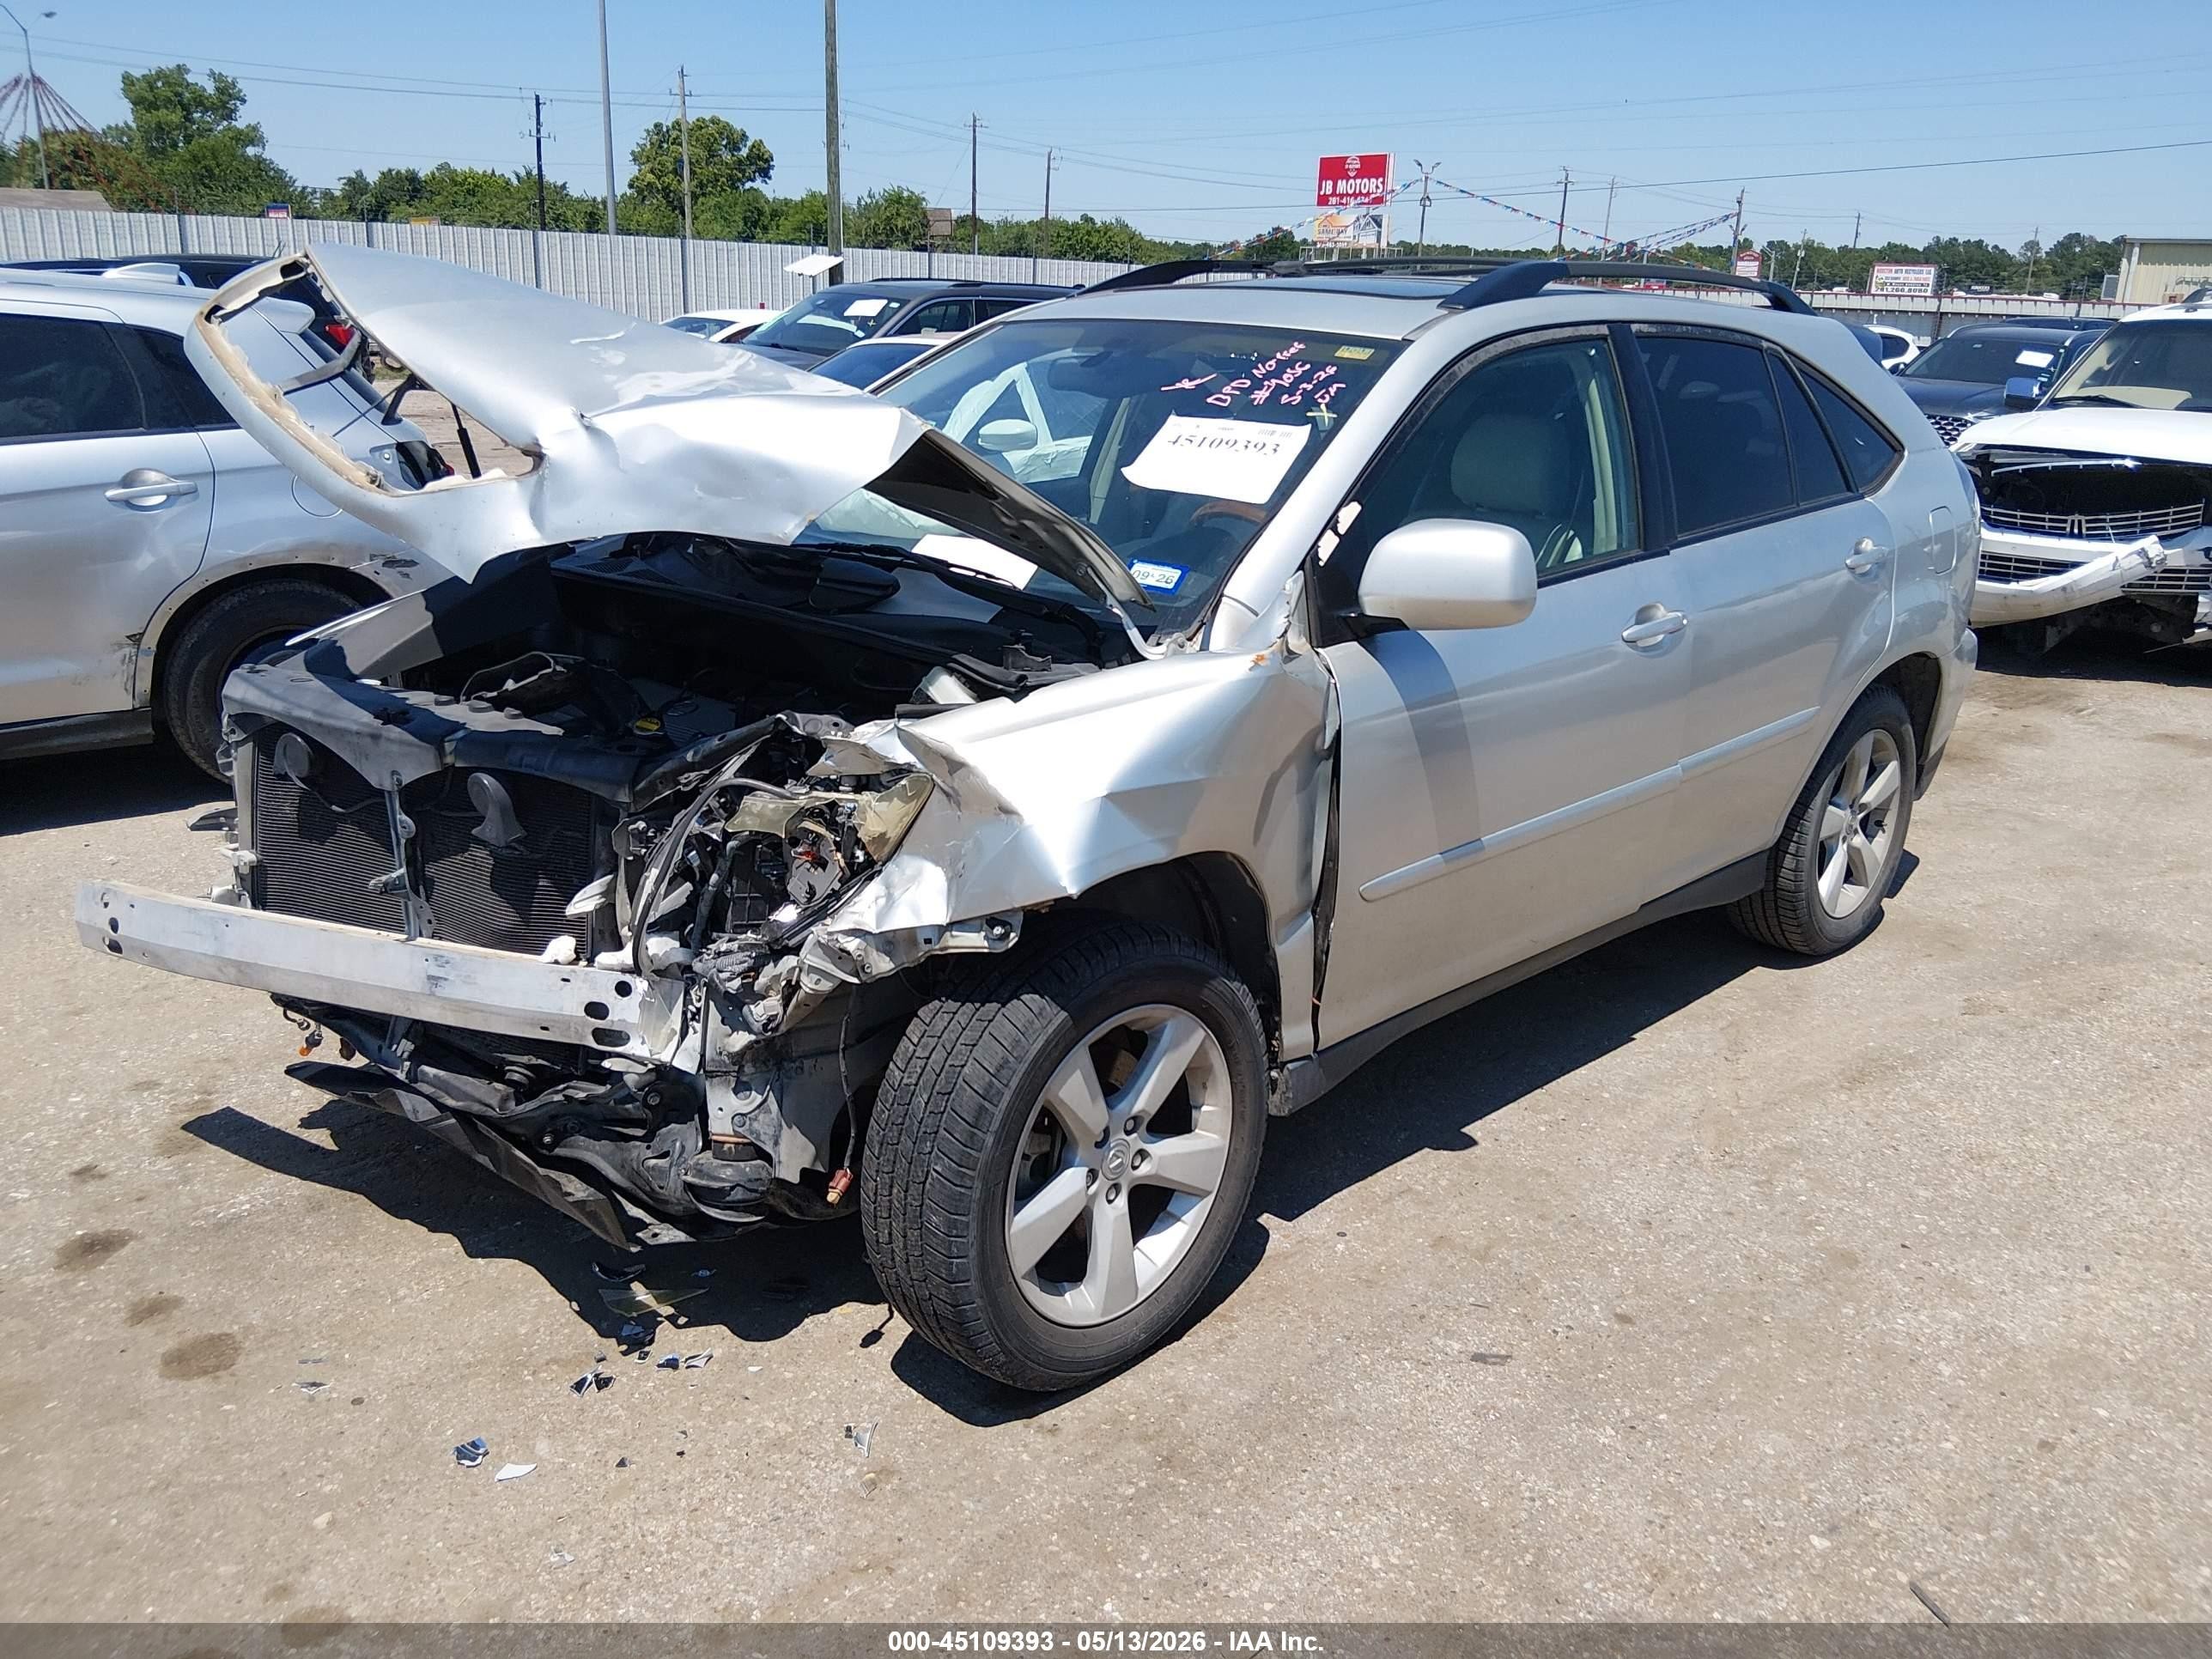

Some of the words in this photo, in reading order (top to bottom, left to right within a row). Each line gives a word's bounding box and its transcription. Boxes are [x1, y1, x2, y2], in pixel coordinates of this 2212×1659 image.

[1320, 179, 1334, 195] JB
[1336, 177, 1383, 195] MOTORS
[1167, 434, 1281, 455] 45109393
[1155, 574, 1176, 585] 26
